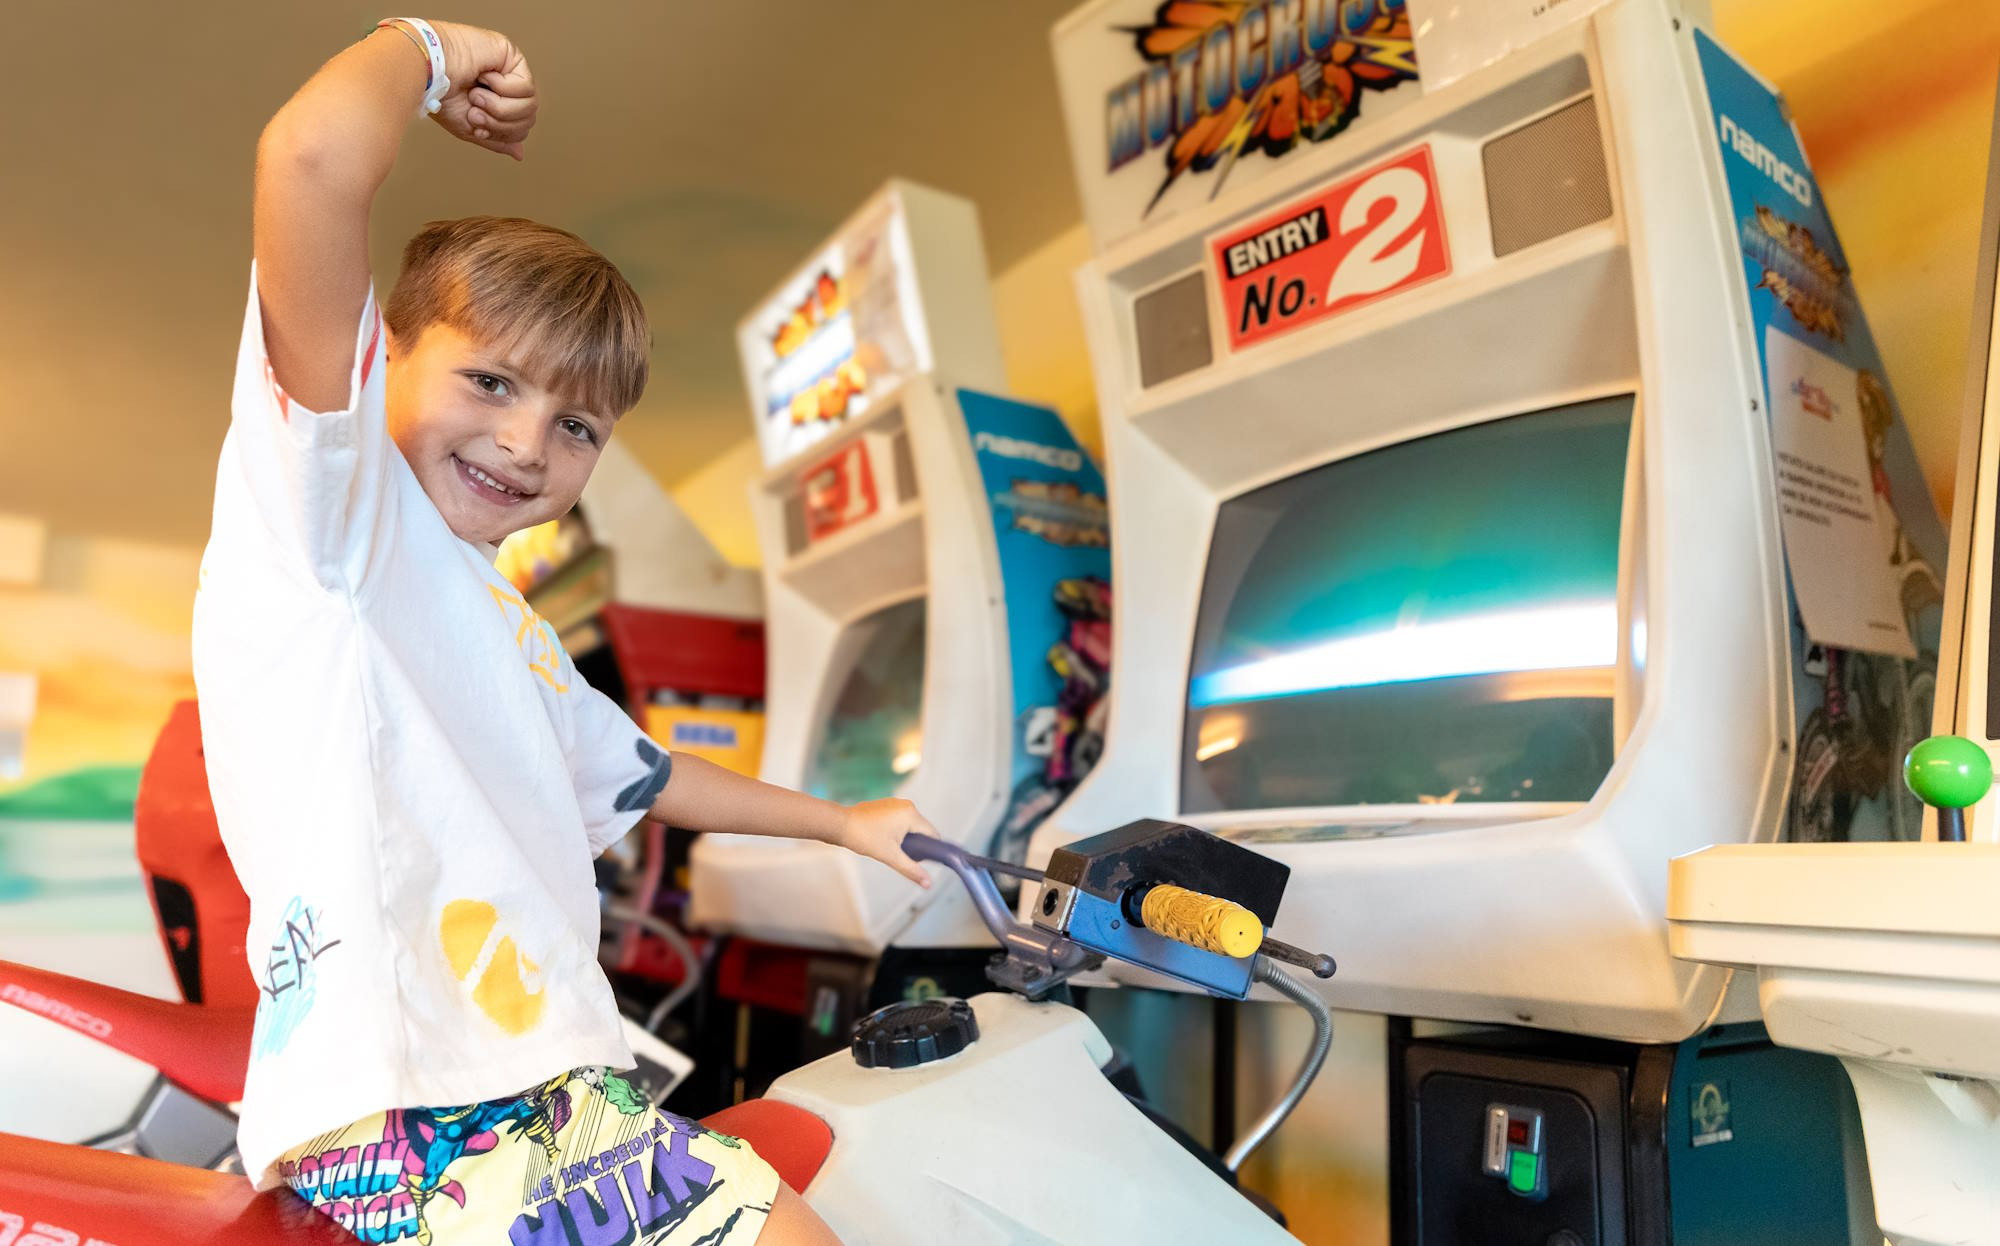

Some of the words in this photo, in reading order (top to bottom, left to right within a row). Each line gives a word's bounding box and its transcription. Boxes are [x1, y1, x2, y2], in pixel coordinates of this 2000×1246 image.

[1106, 0, 1407, 175] MOTOCROS
[1719, 113, 1812, 207] namco
[1228, 210, 1320, 277] ENTRY
[1240, 274, 1315, 333] No.
[1326, 167, 1428, 307] 2
[975, 431, 1081, 471] namco
[1, 984, 113, 1038] namco
[508, 1131, 716, 1246] HULK
